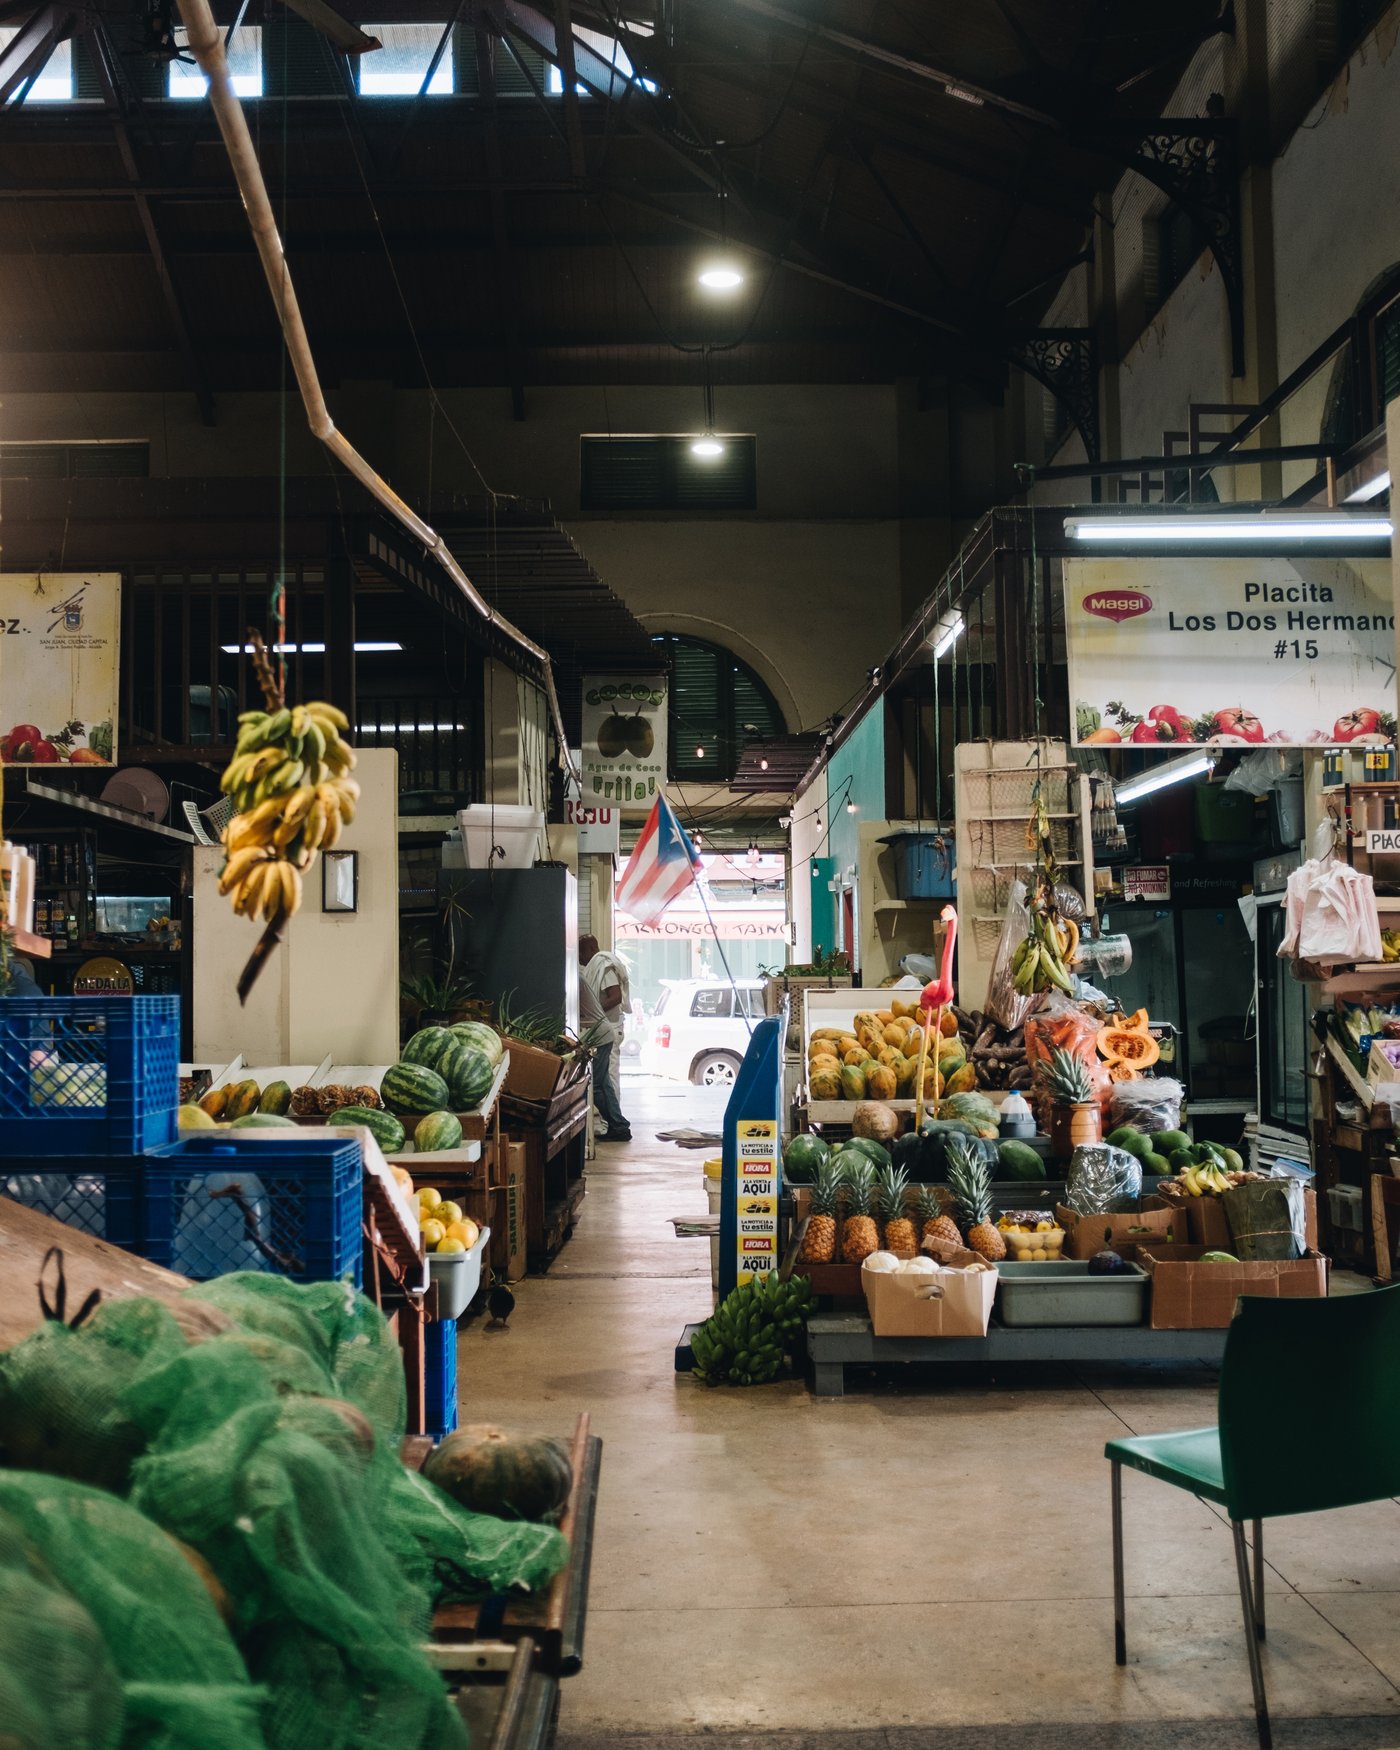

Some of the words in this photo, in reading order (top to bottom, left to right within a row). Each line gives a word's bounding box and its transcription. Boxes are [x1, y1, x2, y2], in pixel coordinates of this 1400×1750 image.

[1244, 582, 1334, 603] Placita
[1091, 598, 1144, 611] Maggi
[1168, 611, 1216, 631] Los
[1227, 611, 1277, 631] Dos
[1274, 640, 1319, 659] #15
[586, 682, 666, 706] COCOS
[588, 763, 614, 773] Agua
[619, 763, 632, 772] de
[1137, 869, 1157, 881] FUMAR
[1139, 882, 1167, 894] SMOKING
[1174, 880, 1189, 888] and
[76, 977, 129, 989] MEDALLA
[745, 1164, 769, 1172] HORA
[745, 1241, 769, 1249] HORA
